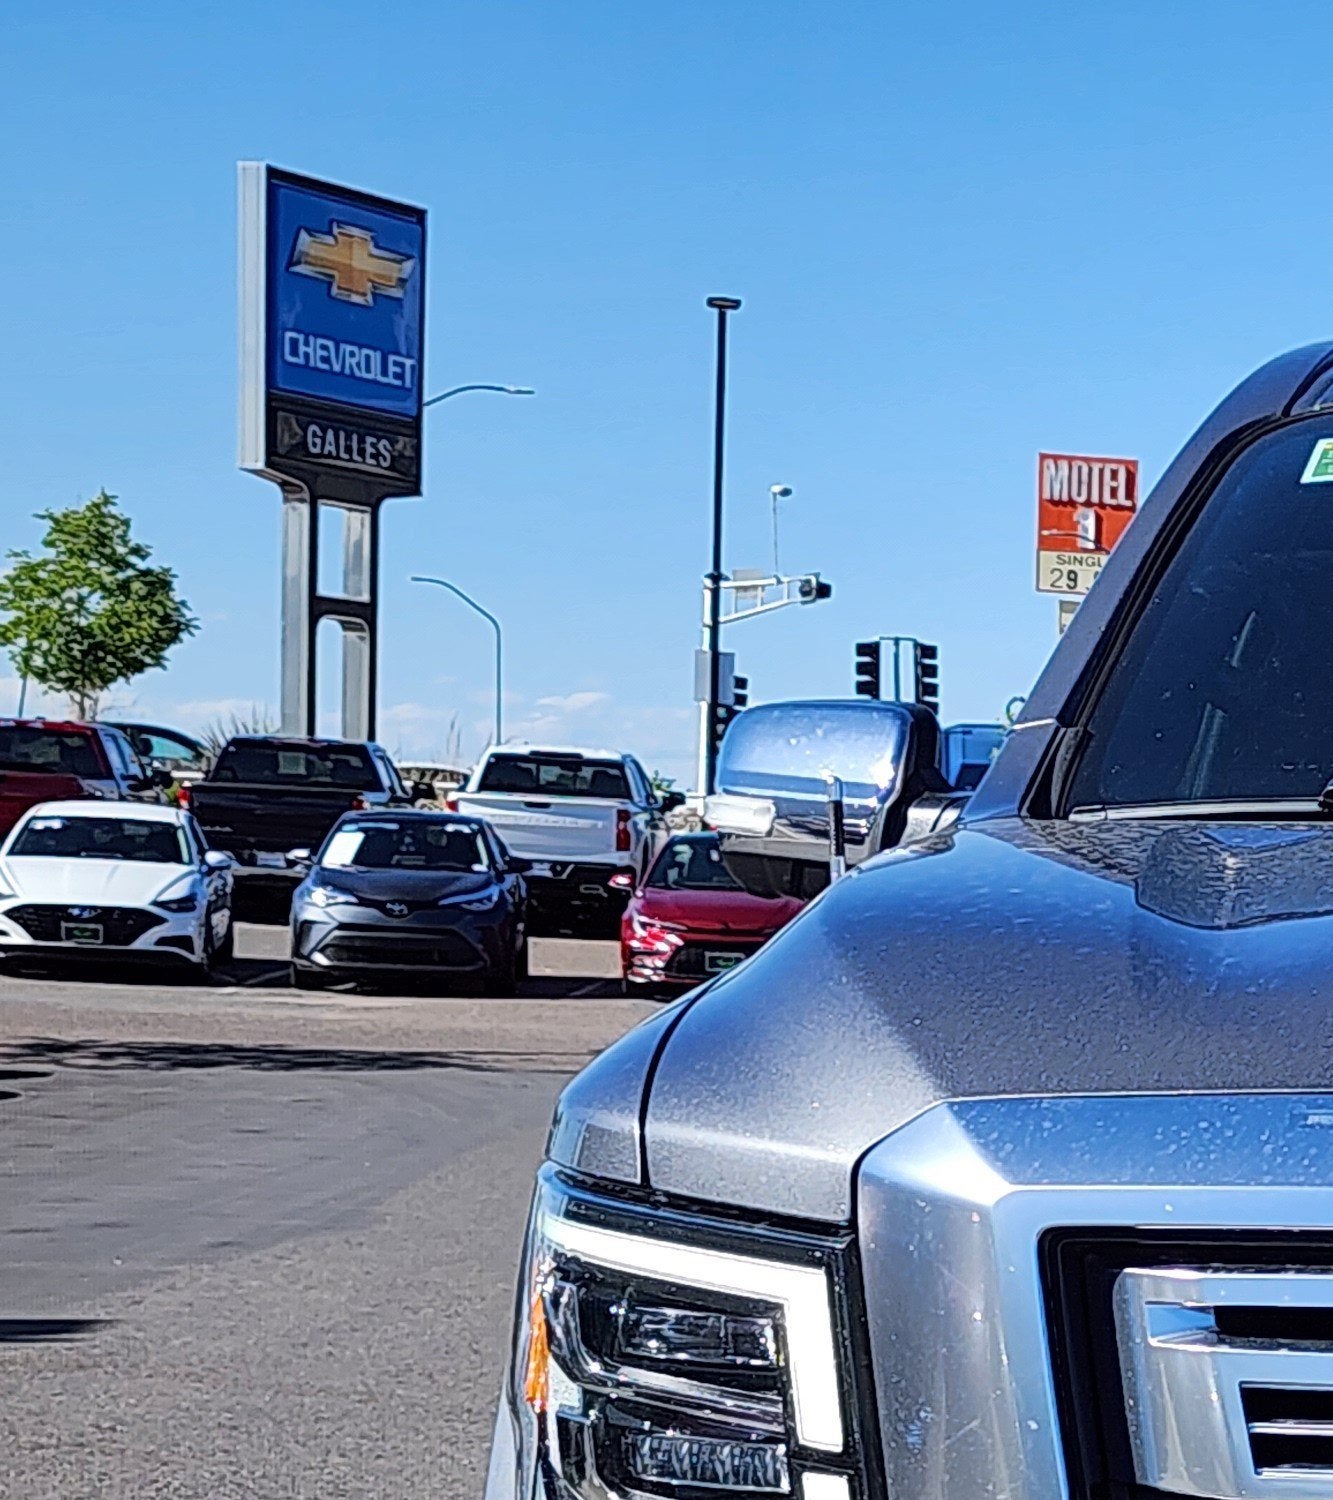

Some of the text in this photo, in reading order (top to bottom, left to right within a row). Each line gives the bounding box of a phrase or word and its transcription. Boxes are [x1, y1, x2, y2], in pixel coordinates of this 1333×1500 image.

[283, 330, 417, 389] CHEVROLET
[306, 423, 394, 468] GALLES
[1043, 458, 1133, 507] MOTEL
[1056, 554, 1104, 568] SINGL
